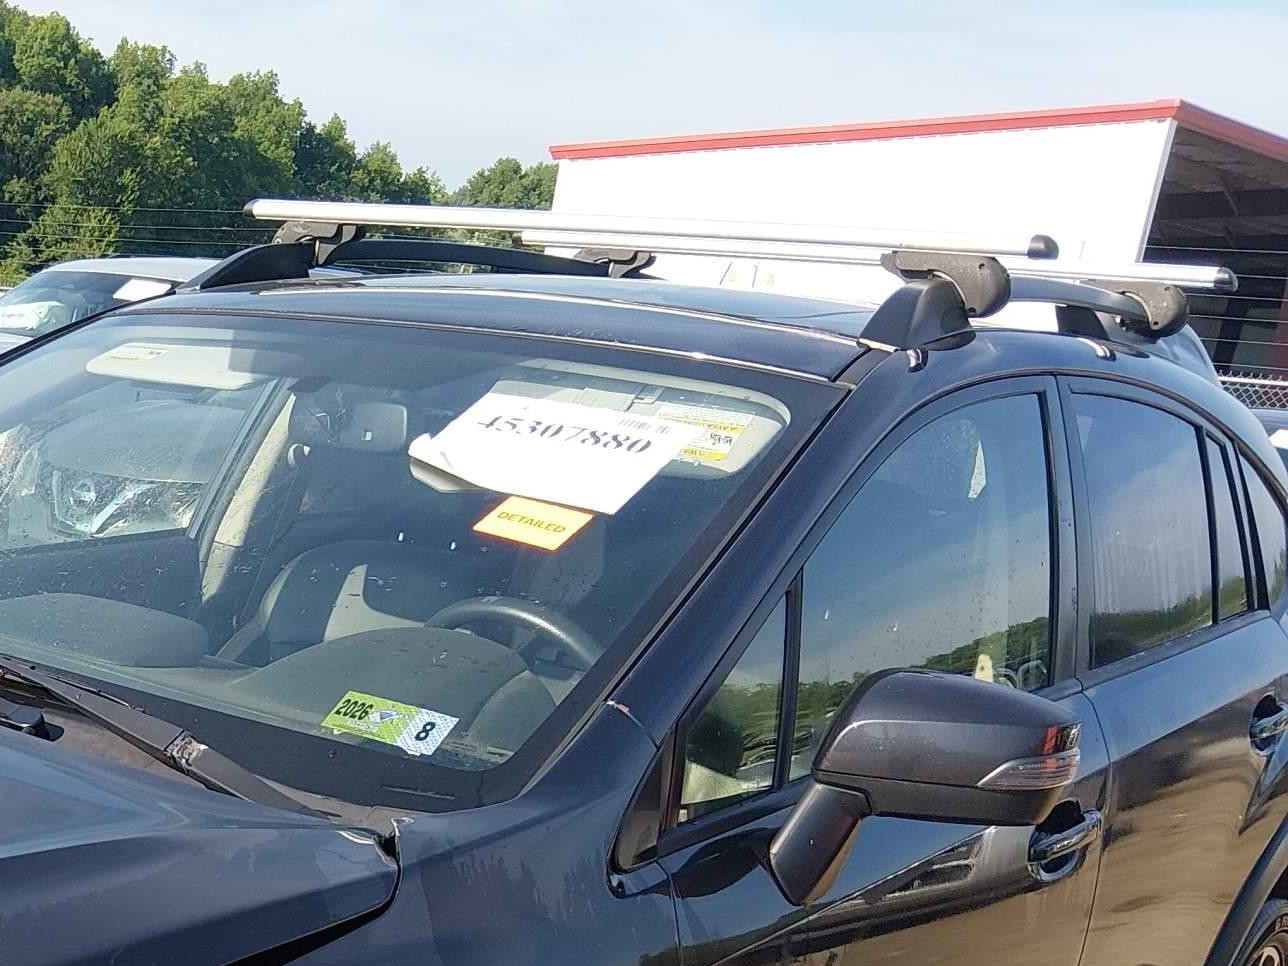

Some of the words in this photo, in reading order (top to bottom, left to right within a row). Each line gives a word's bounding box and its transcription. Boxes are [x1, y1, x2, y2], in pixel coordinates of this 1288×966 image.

[477, 415, 652, 453] 45307880
[497, 511, 566, 533] DETAILED
[335, 699, 374, 721] 2026
[415, 721, 436, 742] 8
